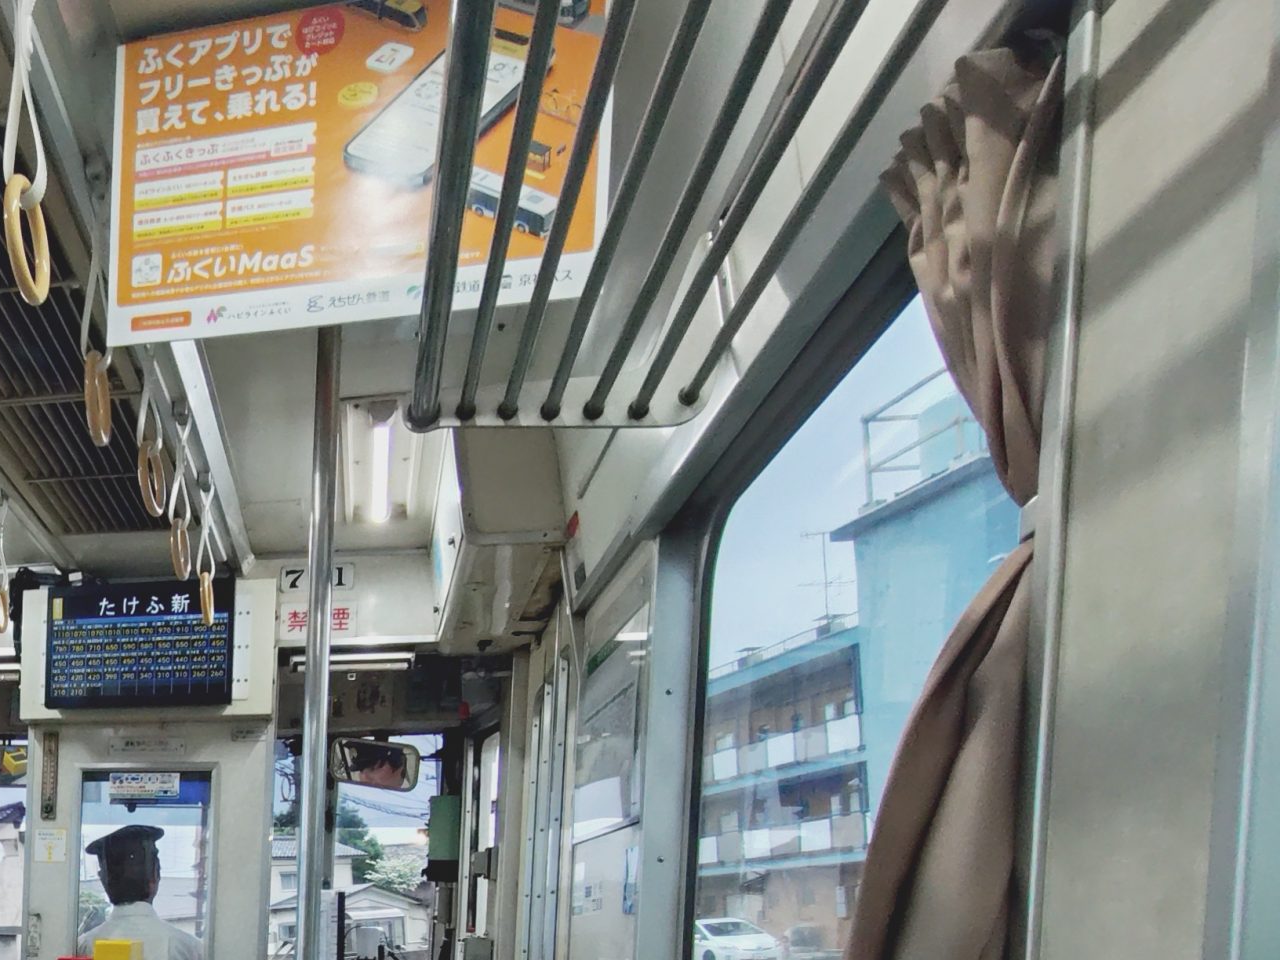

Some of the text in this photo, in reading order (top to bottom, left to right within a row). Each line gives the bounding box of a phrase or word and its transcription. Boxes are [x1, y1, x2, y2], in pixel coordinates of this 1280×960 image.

[138, 23, 292, 74] ふくアプリで
[138, 52, 319, 104] フリーきっぷが
[139, 143, 219, 166] ふくふくきっぷ
[167, 245, 315, 284] ふくいMaaS
[327, 290, 391, 309] えちぜん鉄道
[285, 567, 347, 589] 71
[99, 593, 190, 616] たけふ新
